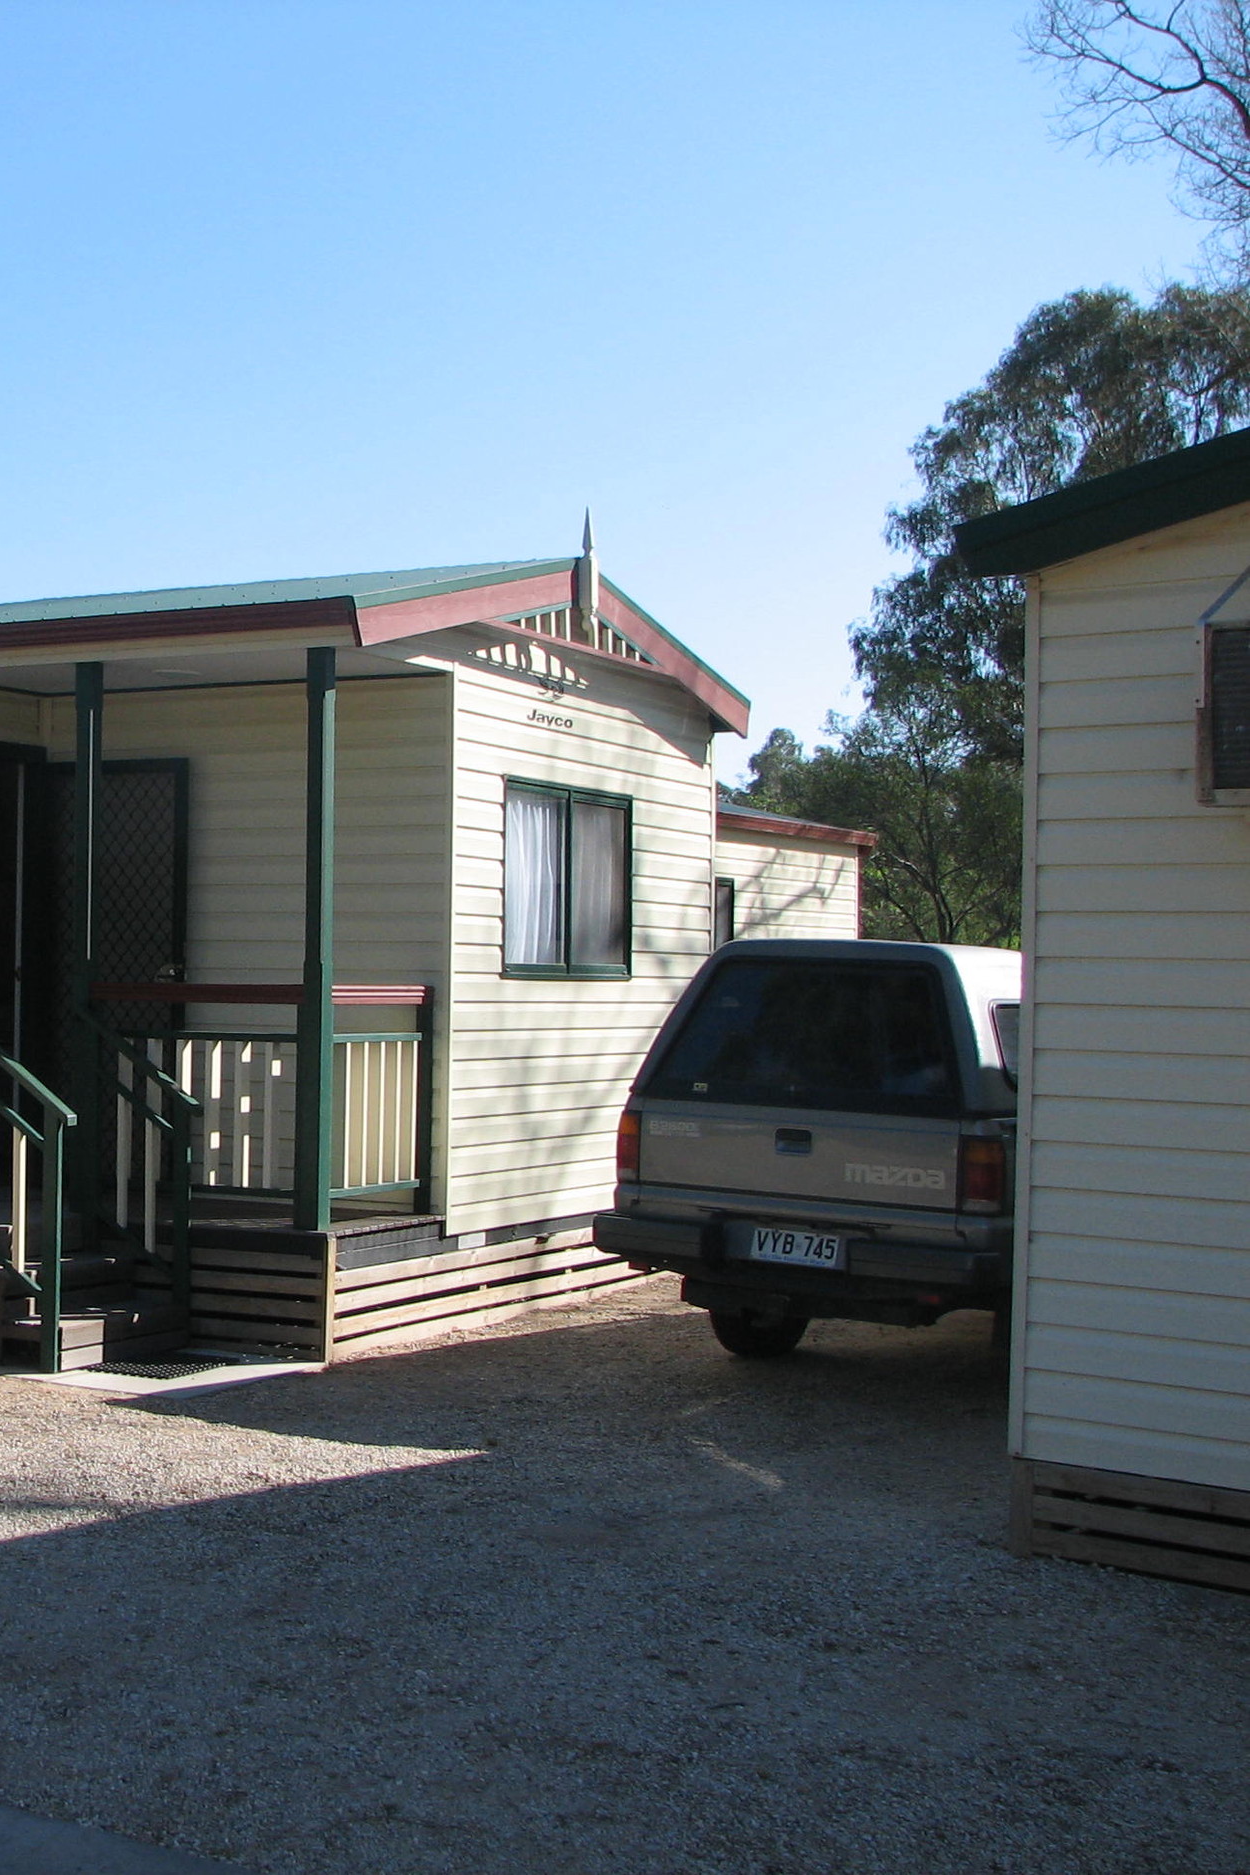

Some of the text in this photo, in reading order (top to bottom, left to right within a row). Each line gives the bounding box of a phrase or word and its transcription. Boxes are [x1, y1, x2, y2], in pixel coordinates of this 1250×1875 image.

[526, 709, 574, 729] Jayco
[845, 1163, 944, 1189] mazda
[756, 1230, 795, 1255] VYB
[803, 1235, 837, 1260] 745
